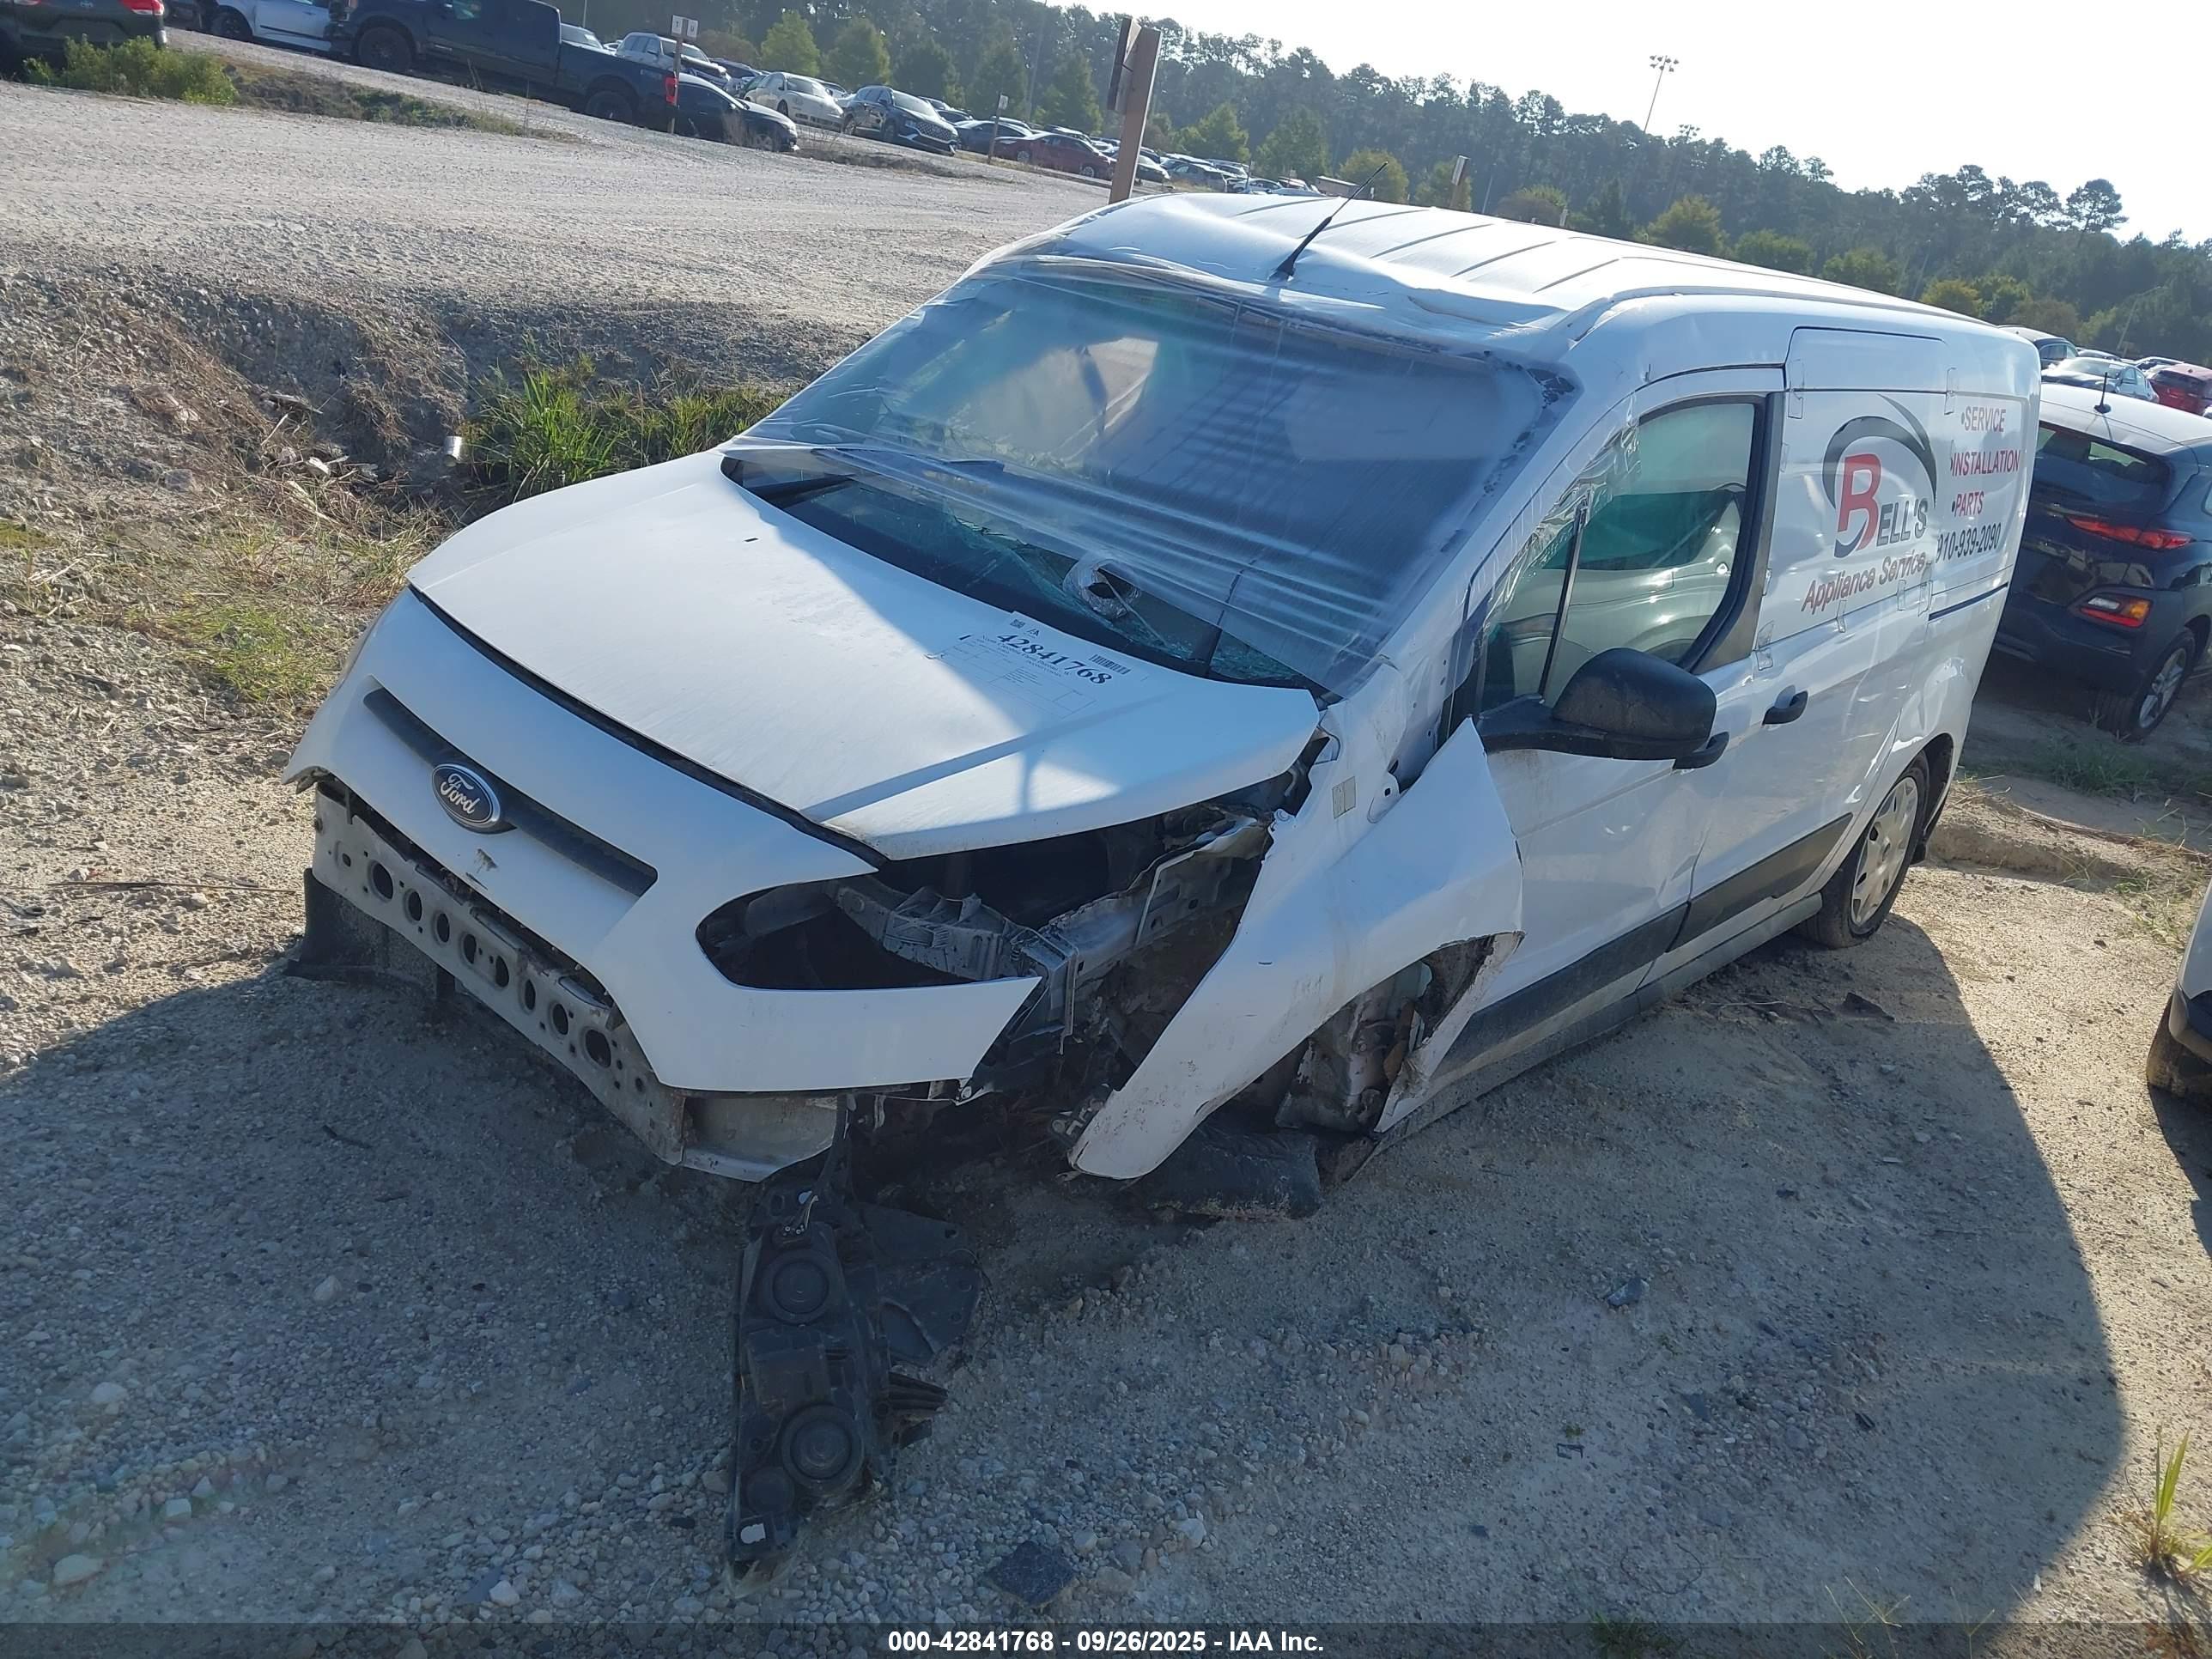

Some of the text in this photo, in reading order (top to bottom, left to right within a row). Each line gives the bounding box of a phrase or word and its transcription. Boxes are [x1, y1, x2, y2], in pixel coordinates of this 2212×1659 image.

[1964, 405, 2007, 433] SERVICE
[1952, 449, 2021, 477] INSTALLATION
[1954, 491, 1984, 517] PARTS
[1936, 522, 2002, 564] 910-939-2090
[1801, 550, 1928, 613] Appliance Service
[996, 634, 1113, 685] 42841768
[440, 773, 481, 814] Ford
